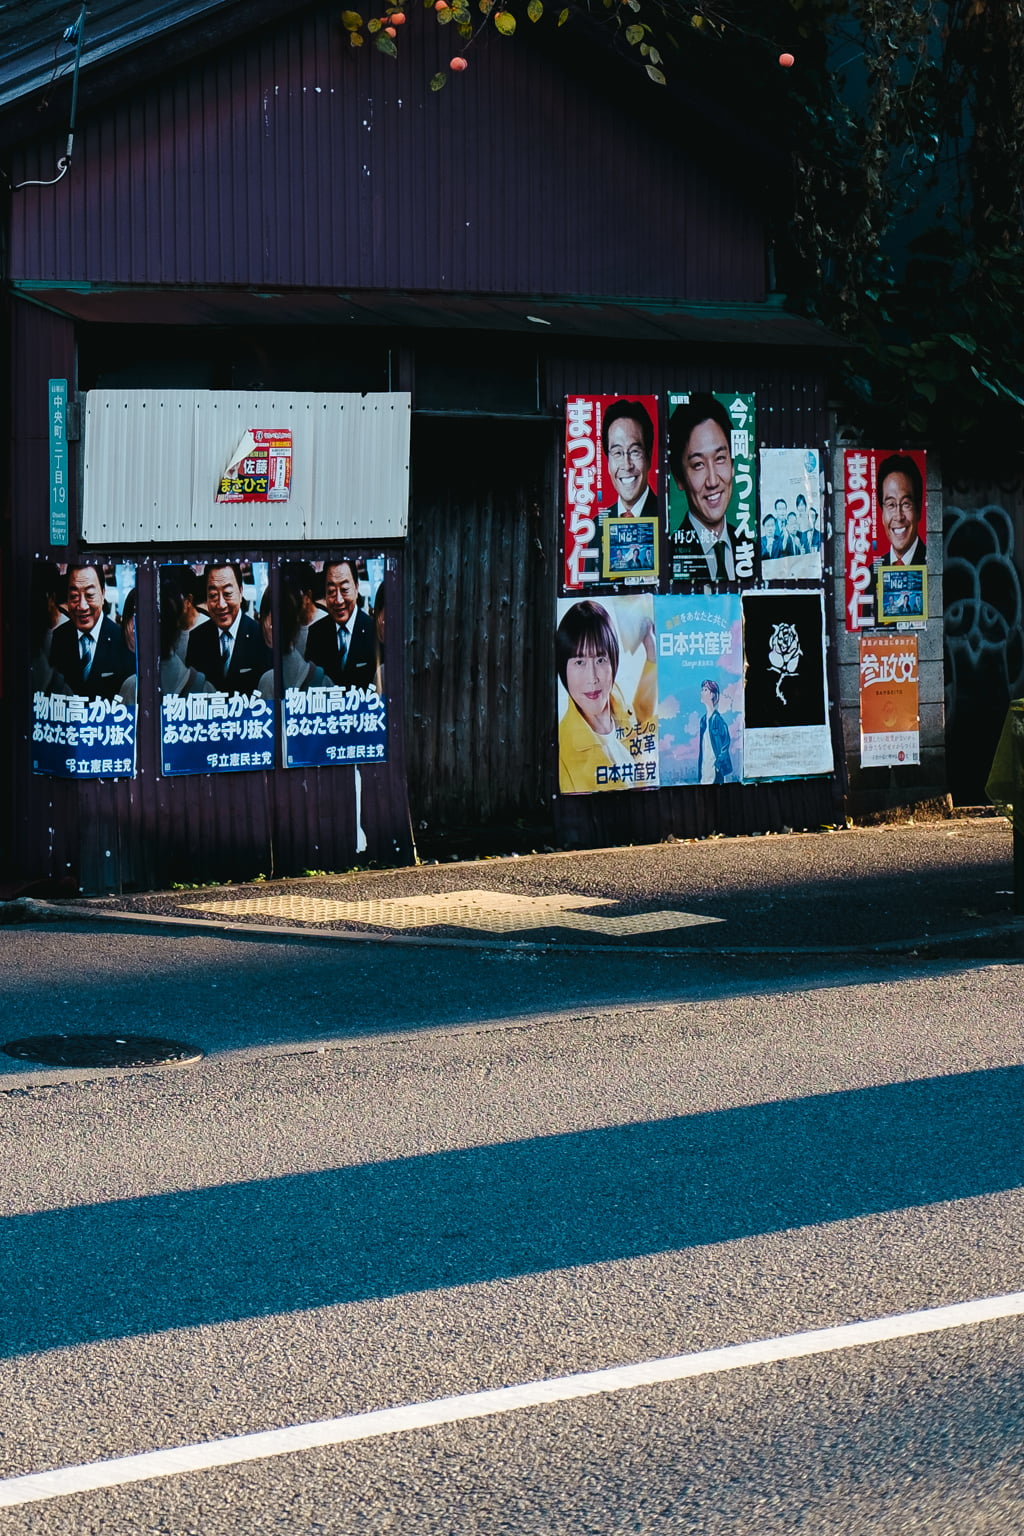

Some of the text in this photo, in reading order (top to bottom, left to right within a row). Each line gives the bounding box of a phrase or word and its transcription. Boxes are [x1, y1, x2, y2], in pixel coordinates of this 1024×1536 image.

[243, 459, 267, 474] 佐藤
[52, 487, 65, 503] 19
[221, 478, 267, 493] まさひさ
[567, 398, 599, 585] まつばら仁
[847, 453, 875, 629] まつばら仁
[660, 631, 733, 656] 日本共産党
[860, 652, 918, 688] 参政党
[33, 690, 133, 723] 物価高から、
[163, 689, 273, 722] 物価高から、
[285, 683, 385, 715] 物価高から、
[32, 722, 134, 746] あなたを守り抜く
[163, 718, 273, 744] あなたを守り抜く
[286, 711, 386, 736] あなたを守り抜く
[615, 721, 656, 740] ホンモノの
[337, 743, 385, 759] 立憲民主党
[629, 734, 656, 756] 改革
[77, 758, 132, 773] 立憲民主党
[218, 751, 272, 767] 立憲民主党
[596, 760, 657, 785] 日本共産党
